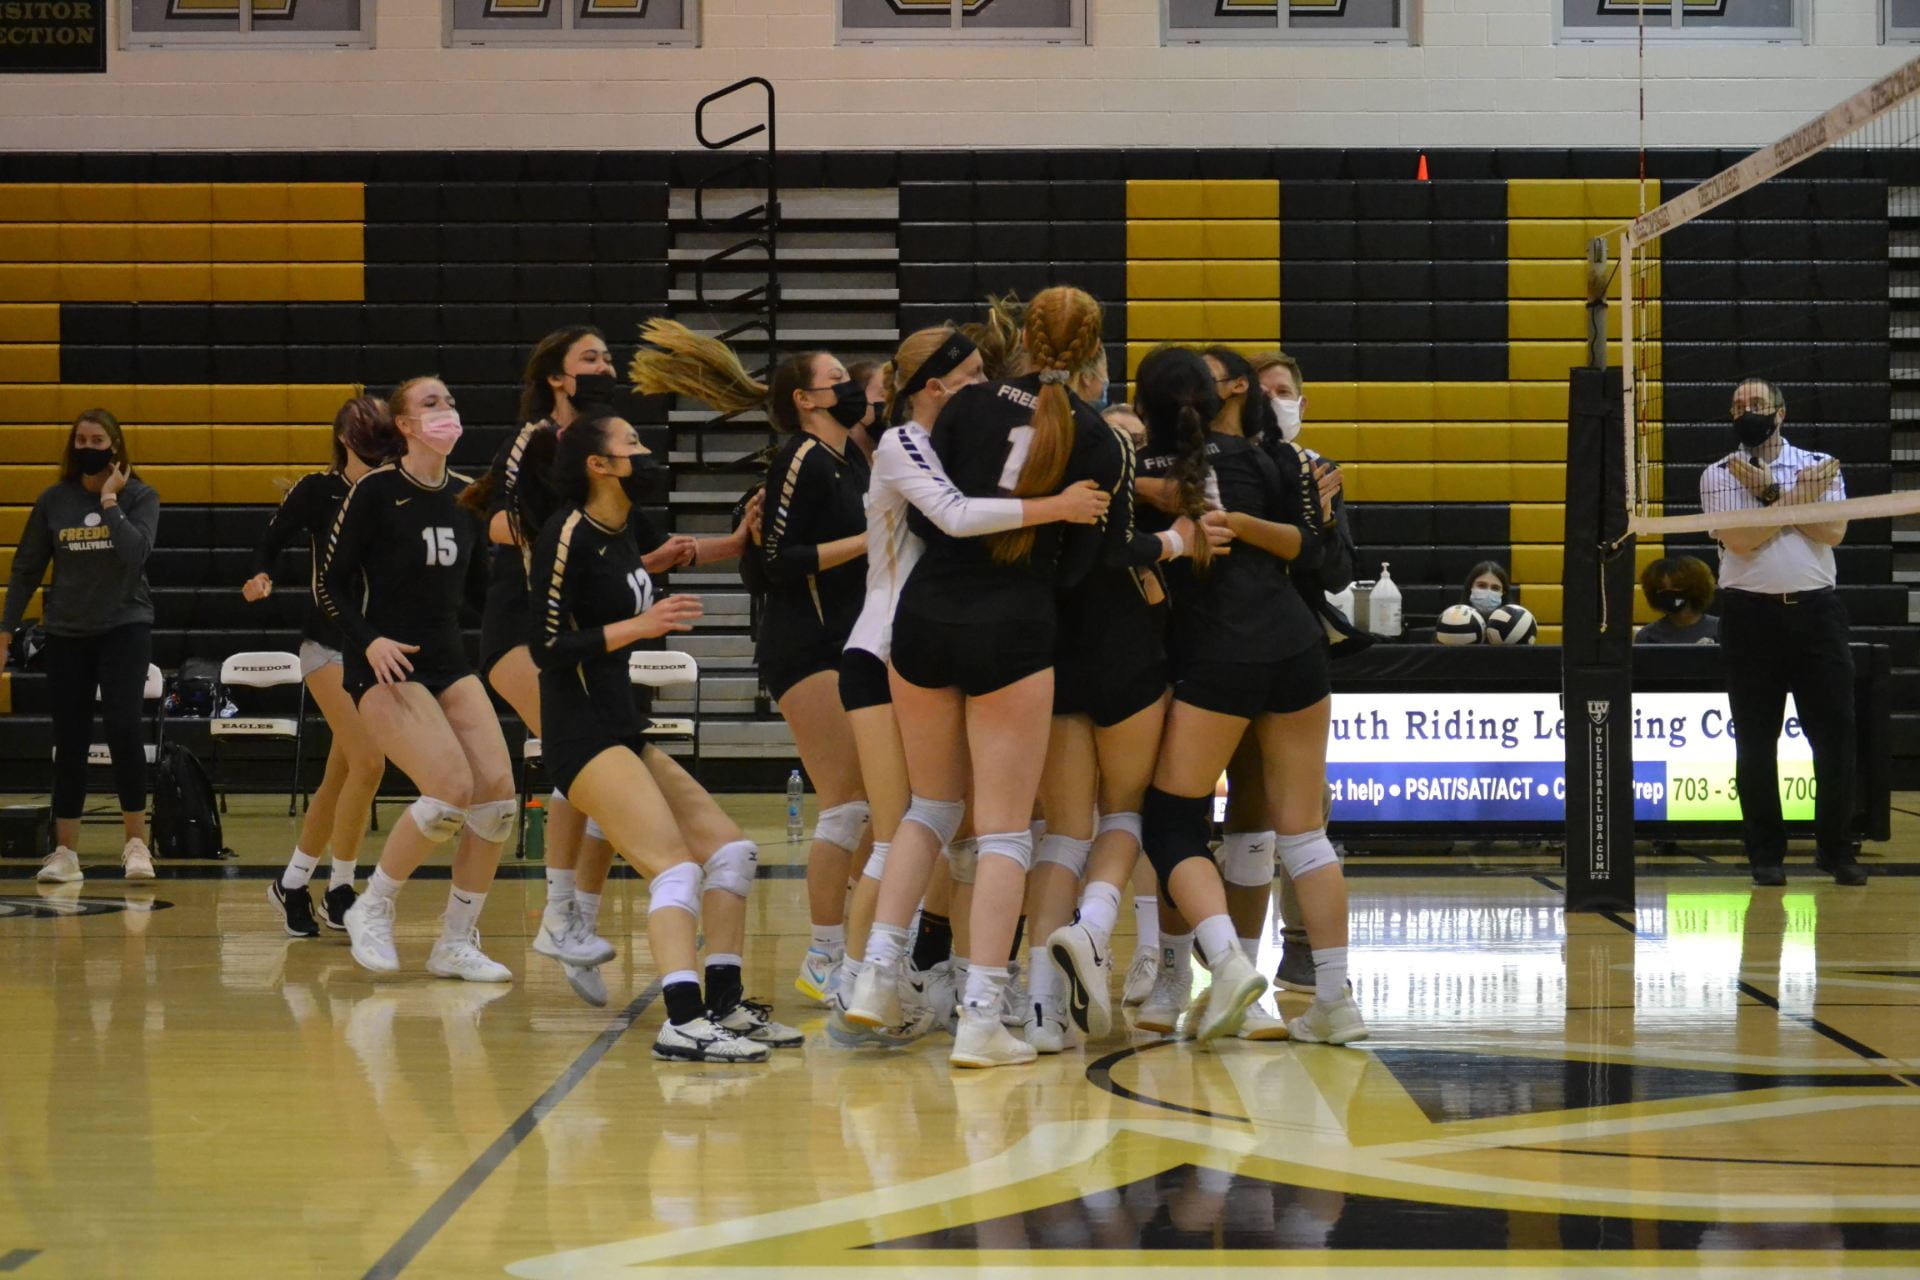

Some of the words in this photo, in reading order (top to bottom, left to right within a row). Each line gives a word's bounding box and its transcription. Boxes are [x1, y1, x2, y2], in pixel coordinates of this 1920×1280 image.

[0, 2, 92, 19] SITOR
[422, 526, 458, 566] 15
[1405, 709, 1519, 748] Riding
[1347, 778, 1384, 805] help
[1405, 777, 1533, 800] PSAT/SAT/ACT
[1633, 780, 1664, 804] rep
[1673, 778, 1709, 801] 703
